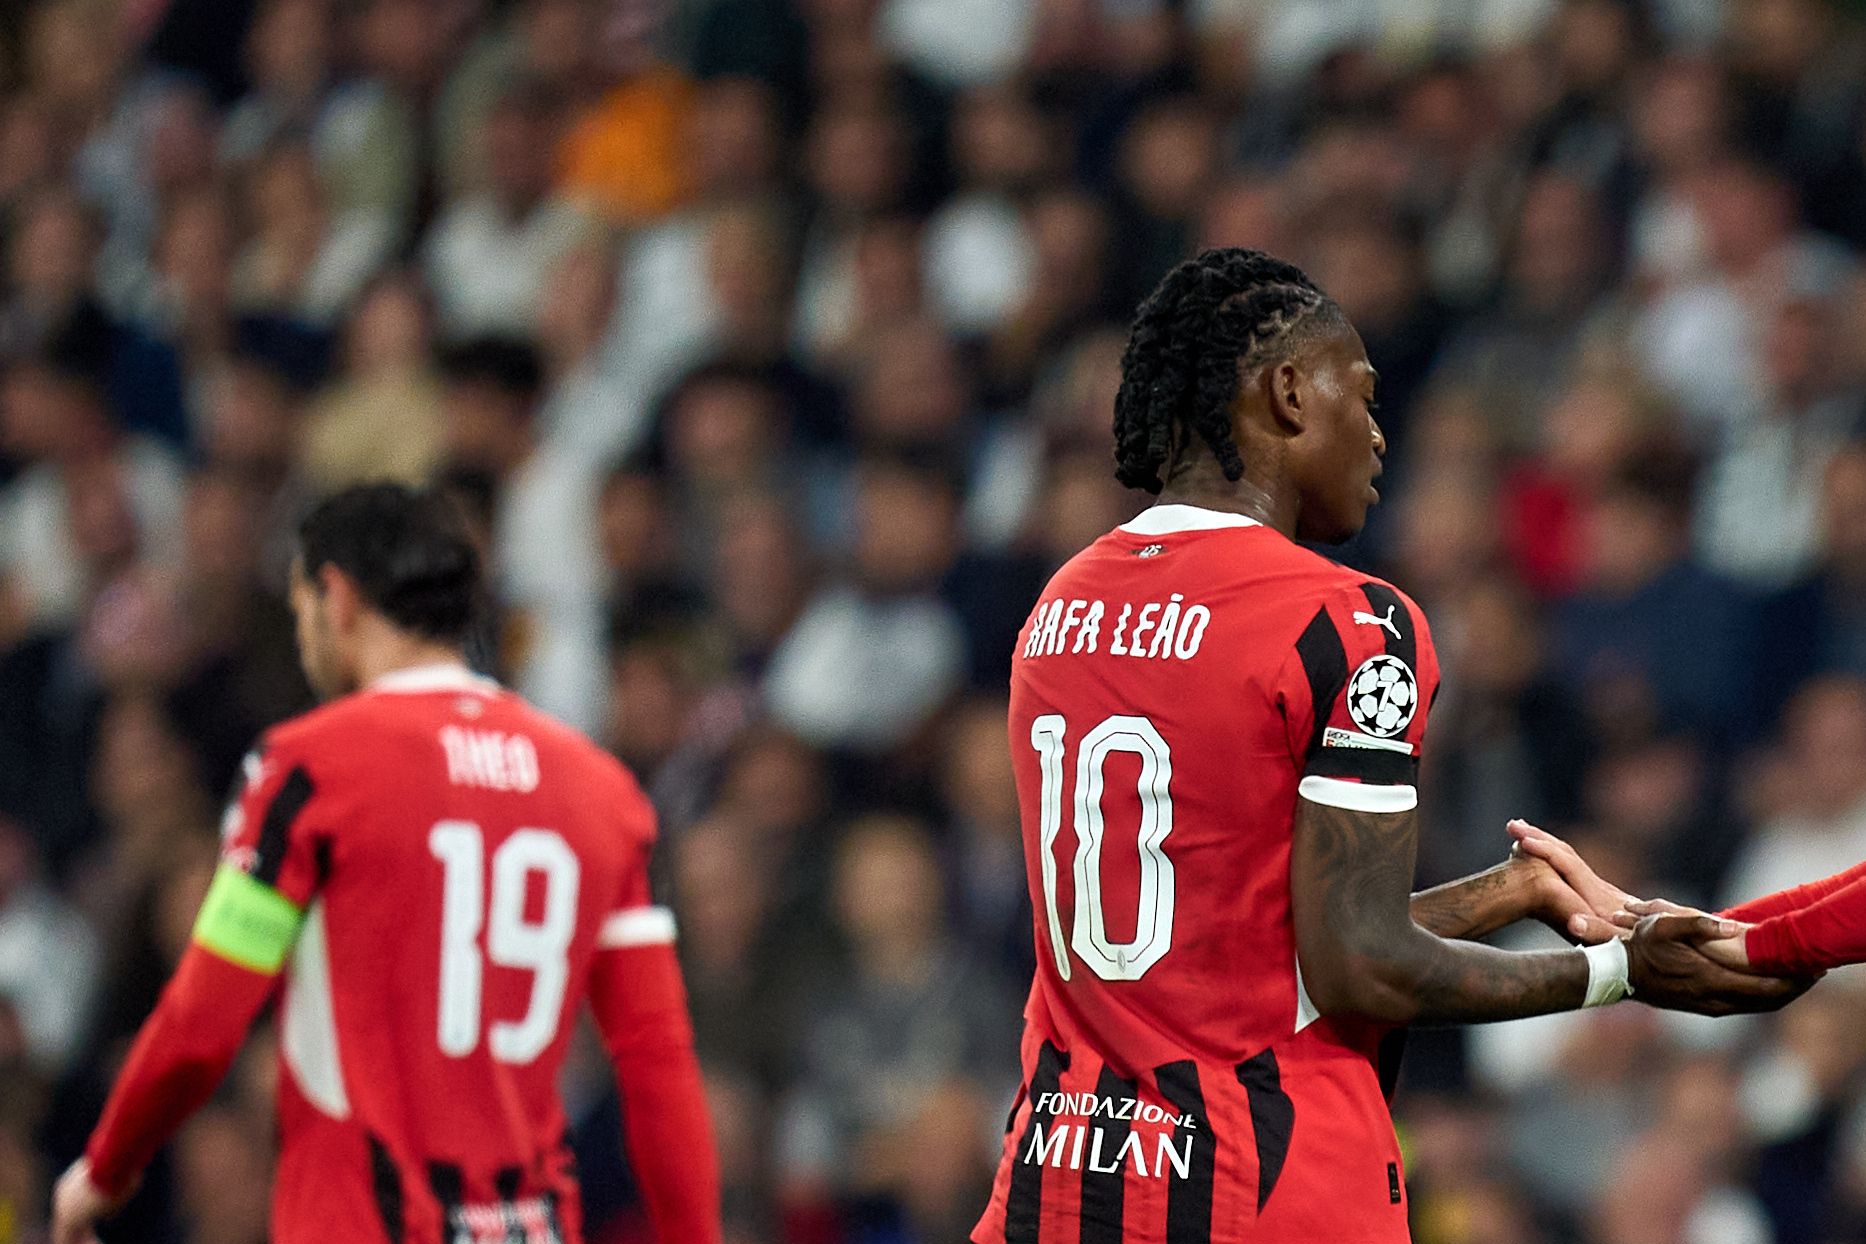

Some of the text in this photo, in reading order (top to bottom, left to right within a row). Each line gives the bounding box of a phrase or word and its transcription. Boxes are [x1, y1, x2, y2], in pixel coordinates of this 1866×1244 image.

[1110, 593, 1211, 660] LEÃO
[1376, 680, 1395, 712] 7
[1030, 714, 1175, 981] 10
[429, 820, 580, 1064] 19
[1035, 1092, 1197, 1129] FONDAZIONE
[1024, 1122, 1194, 1180] MILAN
